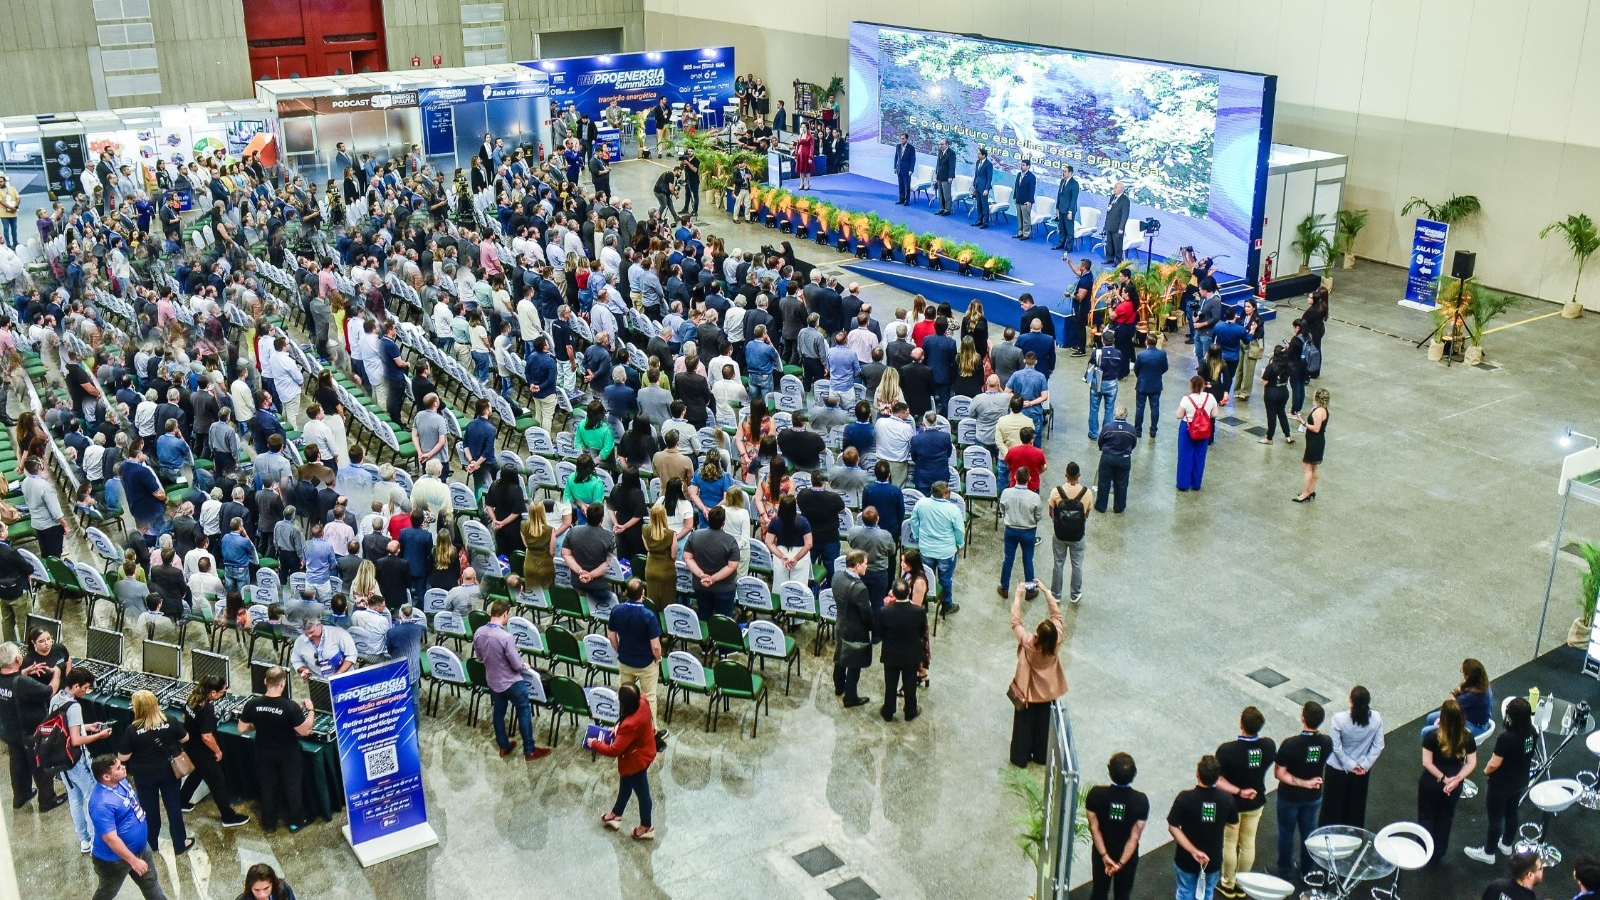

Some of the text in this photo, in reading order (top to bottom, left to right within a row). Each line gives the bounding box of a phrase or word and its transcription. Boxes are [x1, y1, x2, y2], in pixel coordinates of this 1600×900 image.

[593, 68, 665, 84] PROENERGIA
[614, 77, 665, 90] Summit2023
[332, 99, 370, 109] PODCAST
[598, 91, 657, 103] transição energética
[908, 115, 1160, 177] E o teu futuro espelha essa grandeza
[977, 141, 1069, 170] Terra adorada
[1415, 245, 1431, 253] SALA
[337, 676, 407, 703] PROENERGIA
[358, 684, 407, 702] Summit2023
[255, 706, 283, 716] TRADUÇÃO
[347, 692, 408, 714] transição energética
[342, 706, 407, 729] Retire aqui seu fone
[351, 716, 401, 735] para participar
[357, 723, 396, 740] da palestra!
